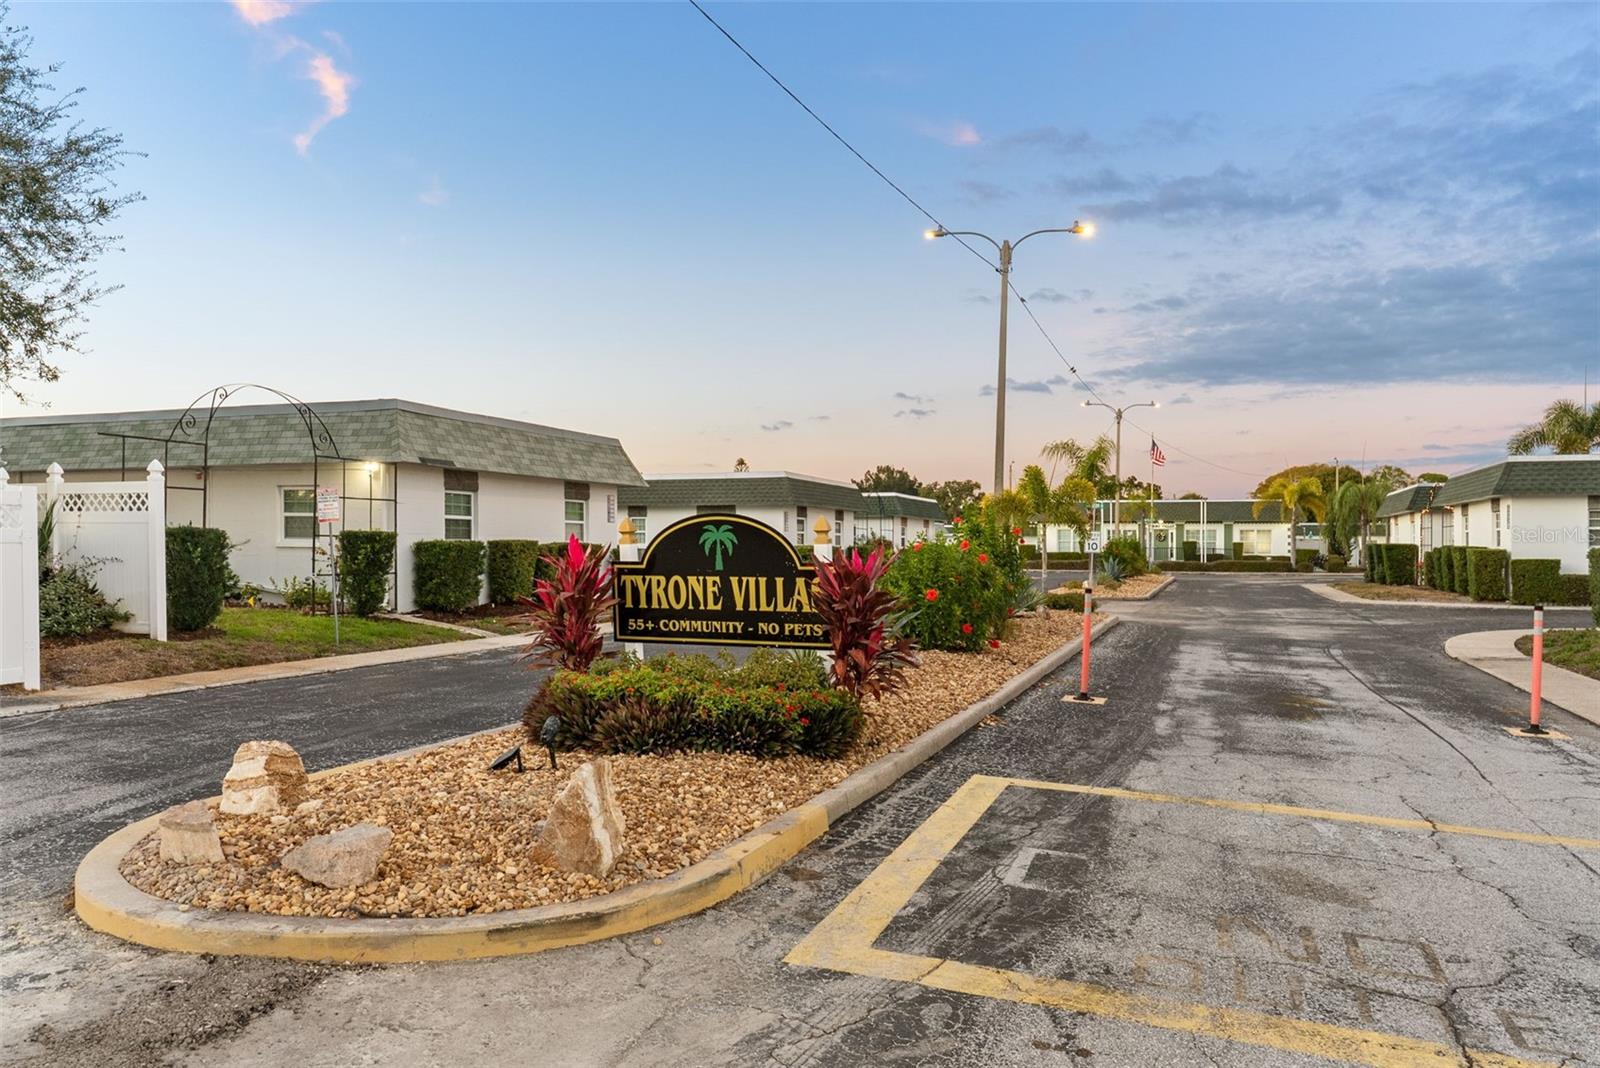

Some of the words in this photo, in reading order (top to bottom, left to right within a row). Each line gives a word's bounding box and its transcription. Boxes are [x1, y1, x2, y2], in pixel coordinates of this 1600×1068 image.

[1087, 542, 1099, 551] 10
[620, 574, 723, 611] TYRONE
[627, 618, 655, 631] 55+
[658, 618, 745, 634] COMMUNITY
[757, 622, 780, 635] NO
[784, 623, 824, 637] PETS
